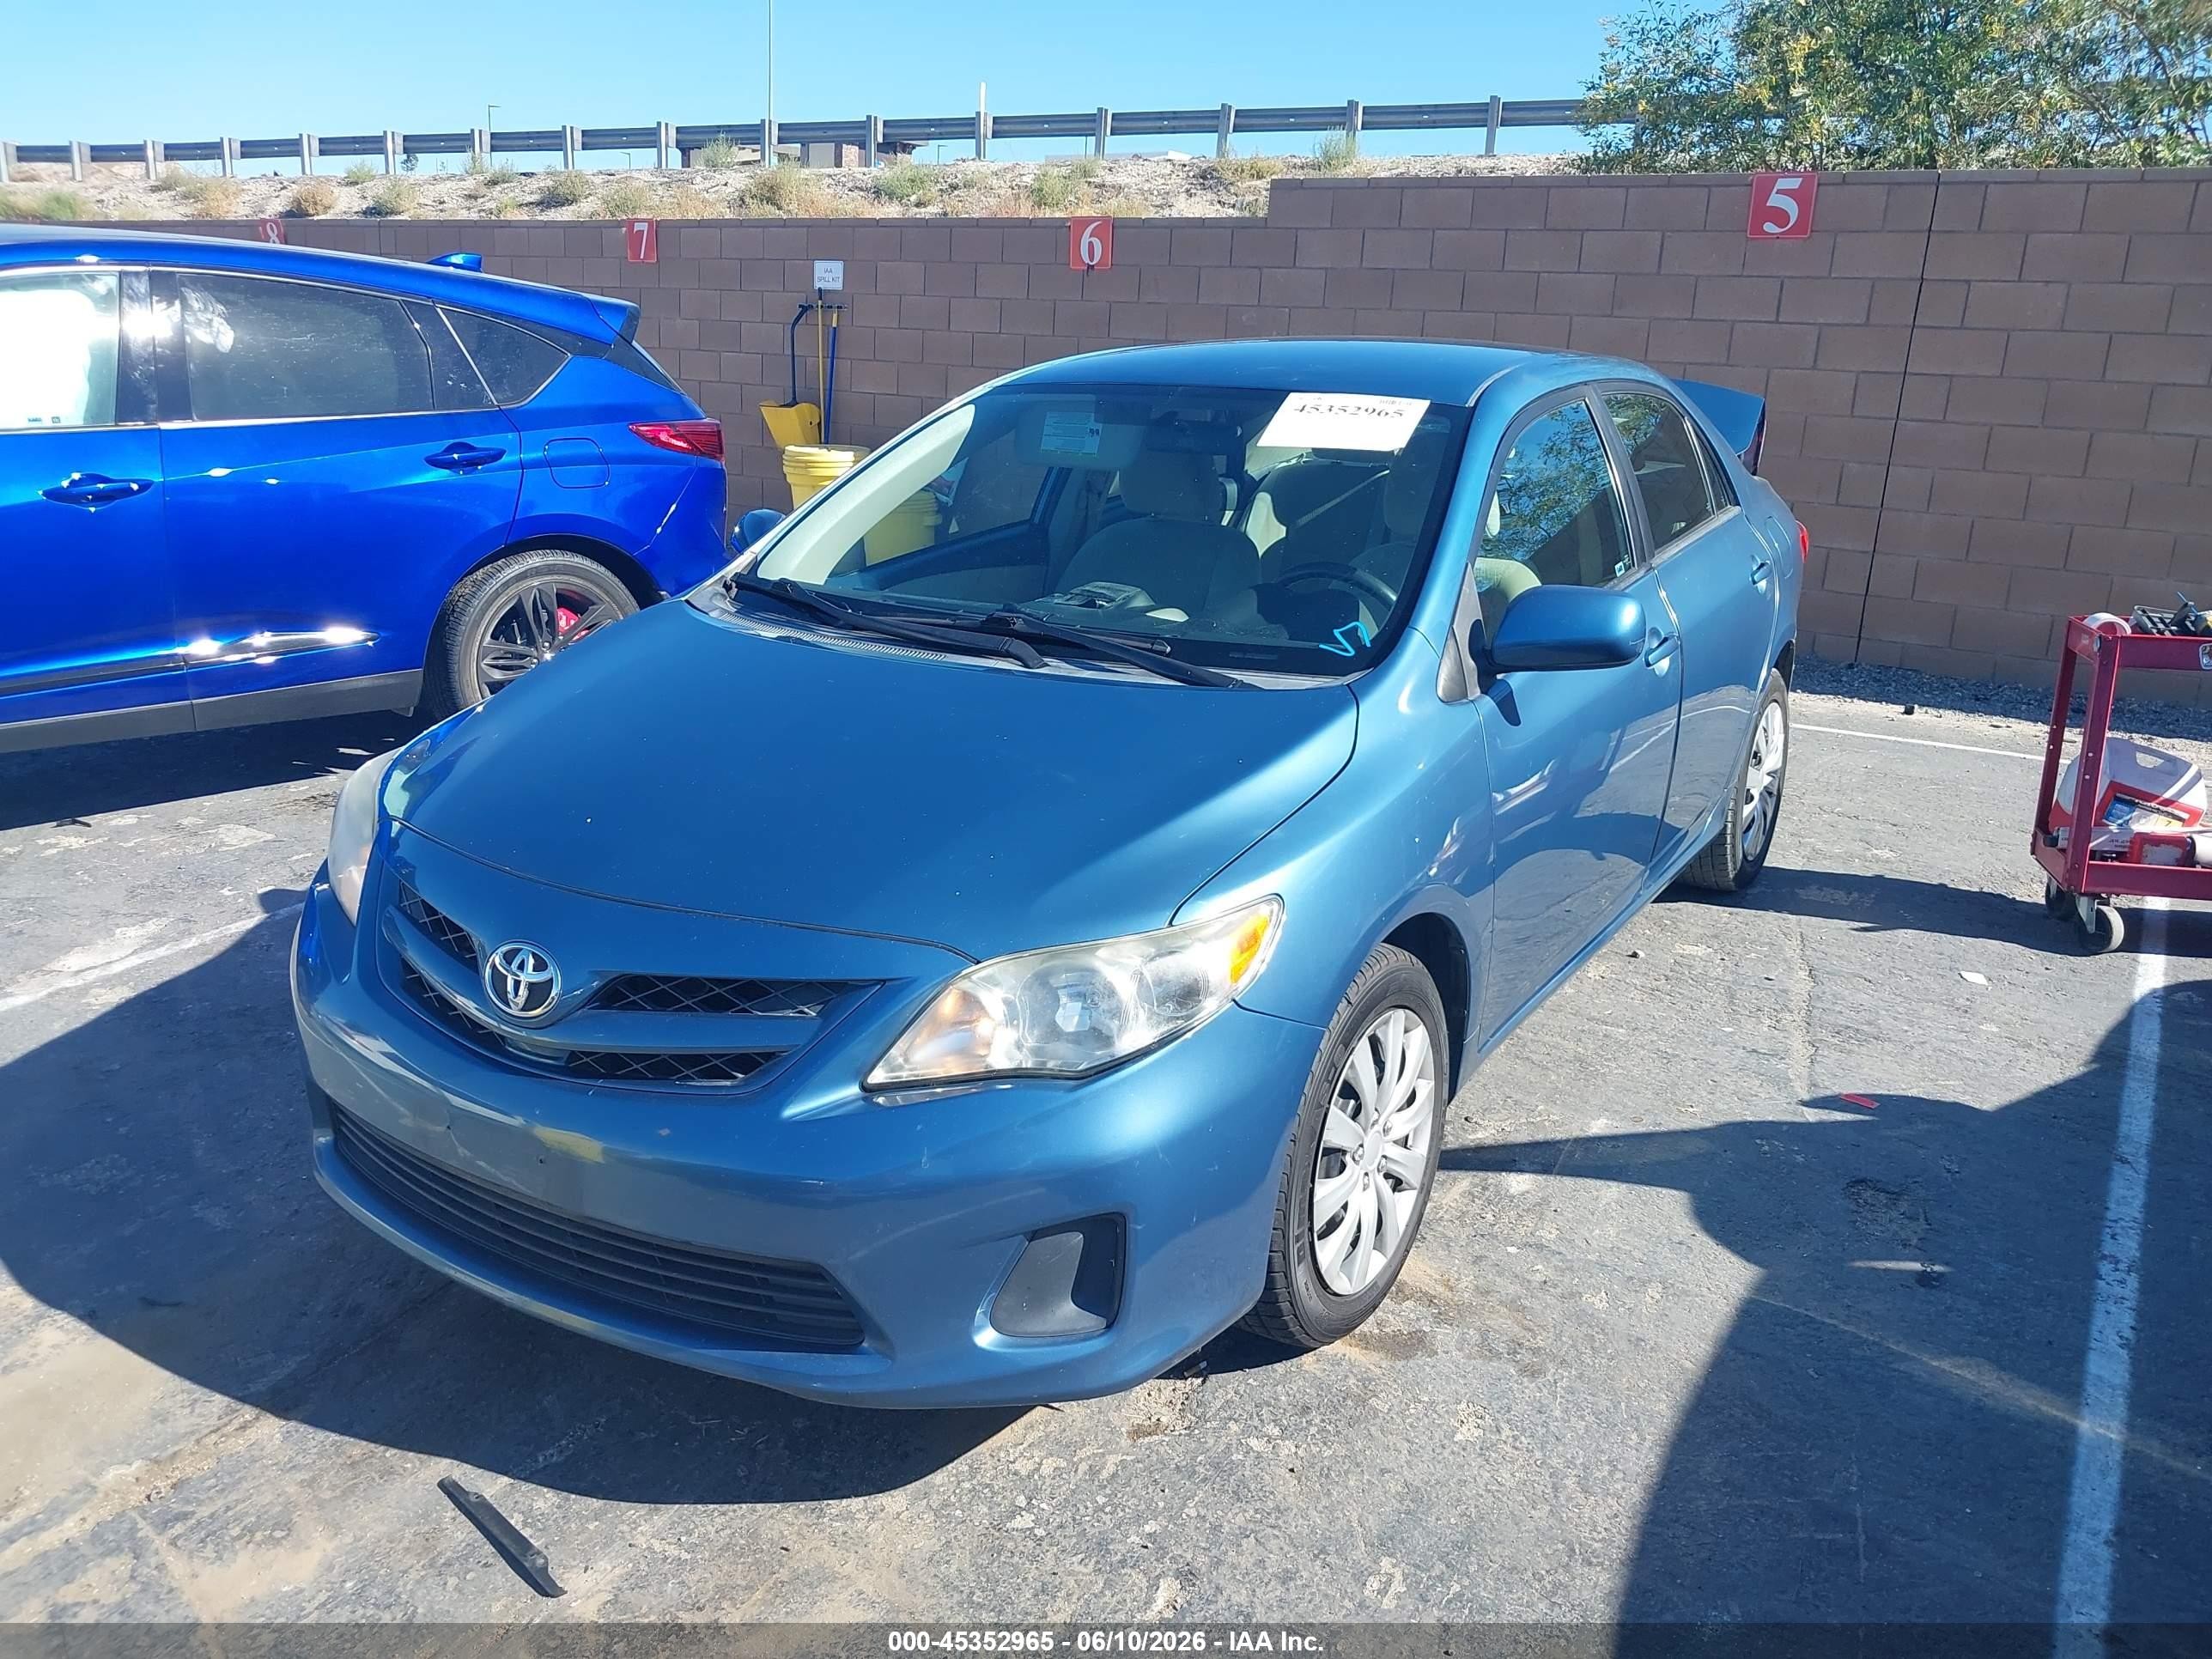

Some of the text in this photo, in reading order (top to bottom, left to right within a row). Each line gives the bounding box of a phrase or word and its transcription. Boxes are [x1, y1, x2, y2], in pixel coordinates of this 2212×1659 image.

[1763, 177, 1803, 234] 5
[633, 222, 648, 259] 7
[1079, 221, 1103, 265] 6
[1293, 404, 1407, 418] 45352965
